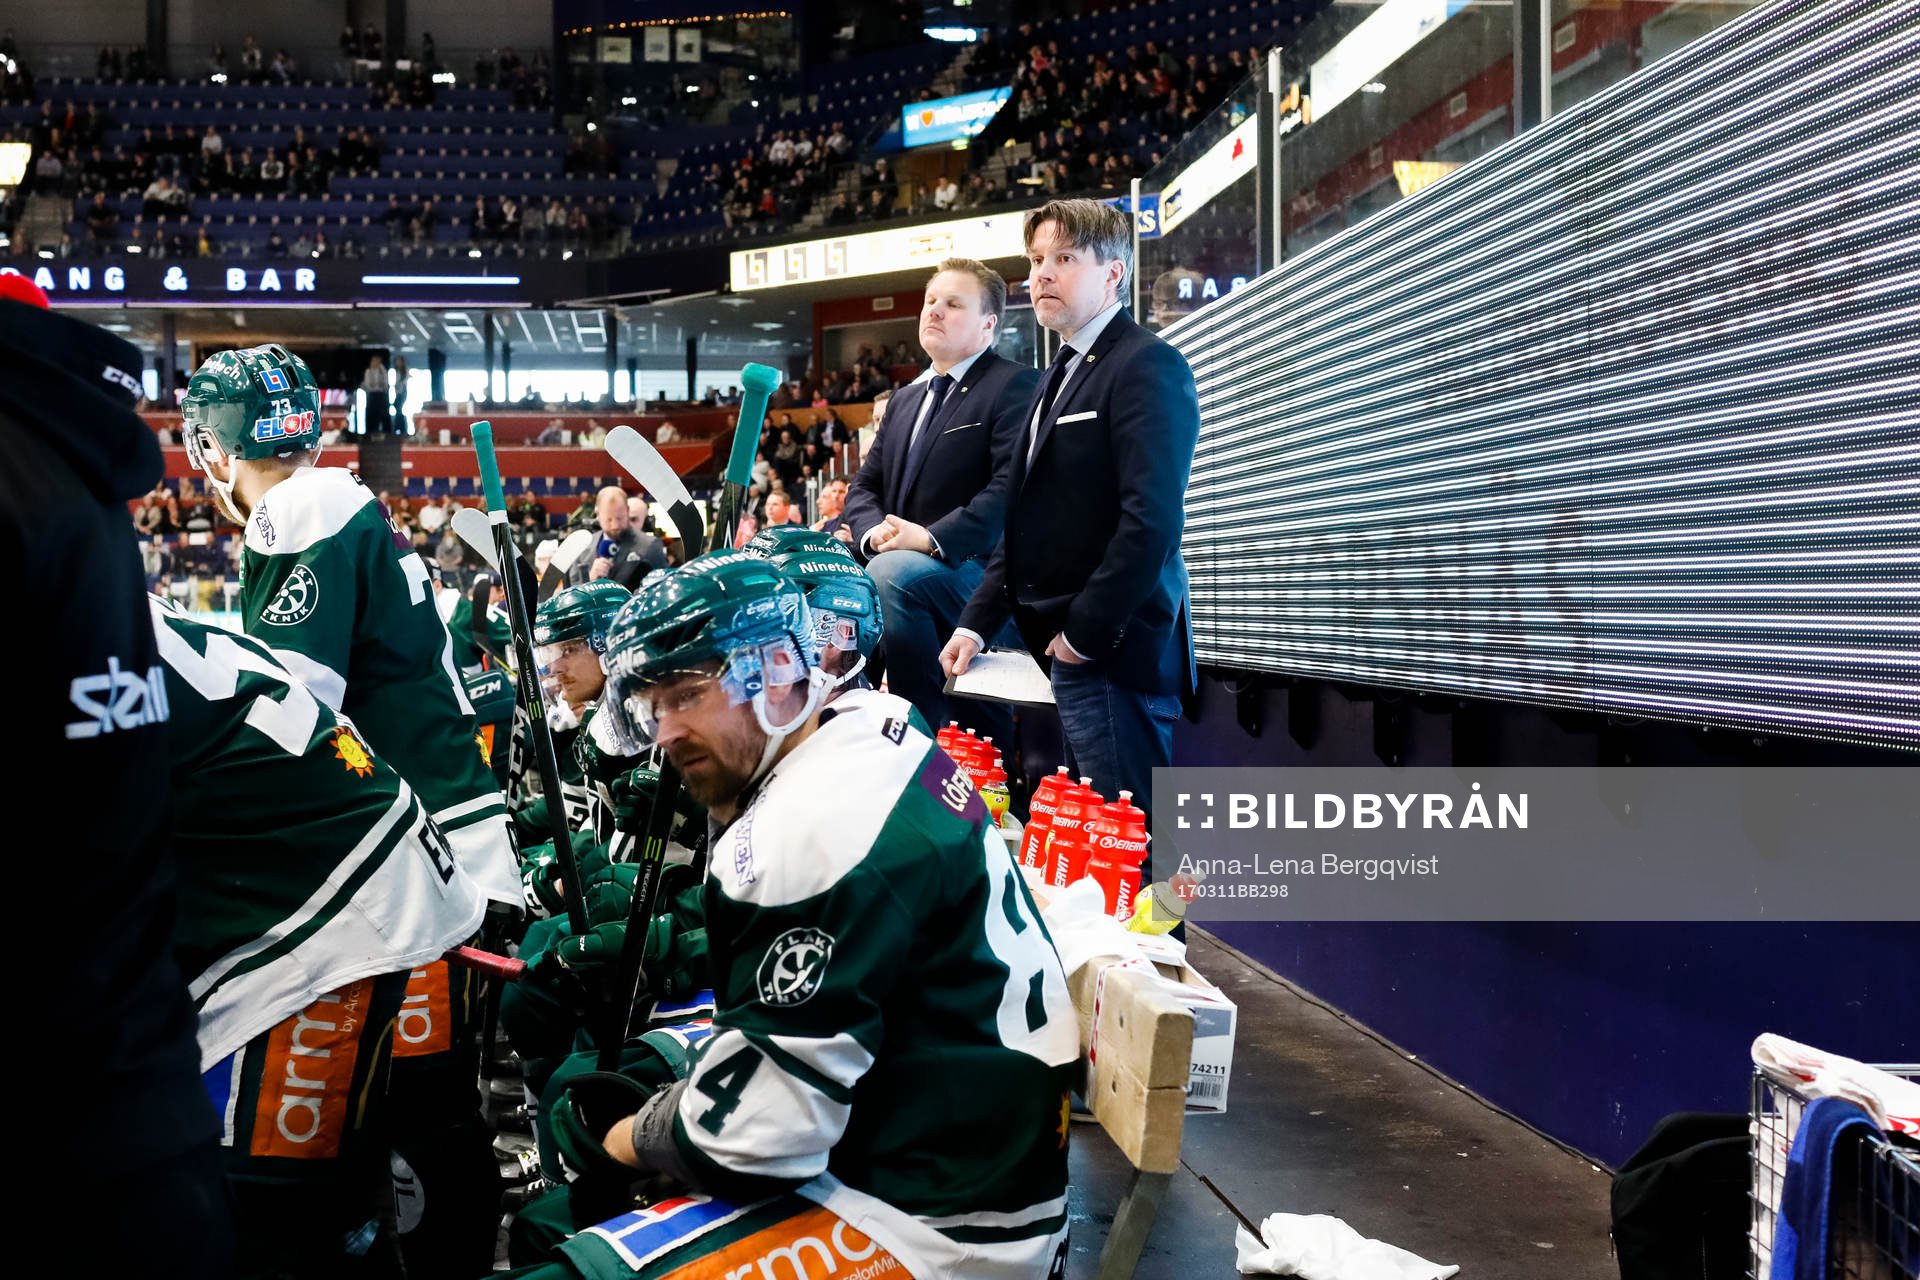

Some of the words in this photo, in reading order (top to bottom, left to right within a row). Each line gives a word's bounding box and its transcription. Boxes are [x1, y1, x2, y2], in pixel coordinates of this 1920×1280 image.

[0, 266, 126, 291] ANG
[163, 266, 188, 291] &
[226, 267, 316, 291] BAR
[271, 398, 293, 416] 73
[256, 412, 315, 442] ELON
[799, 561, 864, 578] Ninetech
[833, 598, 862, 610] CCM
[1192, 1063, 1226, 1075] 74211
